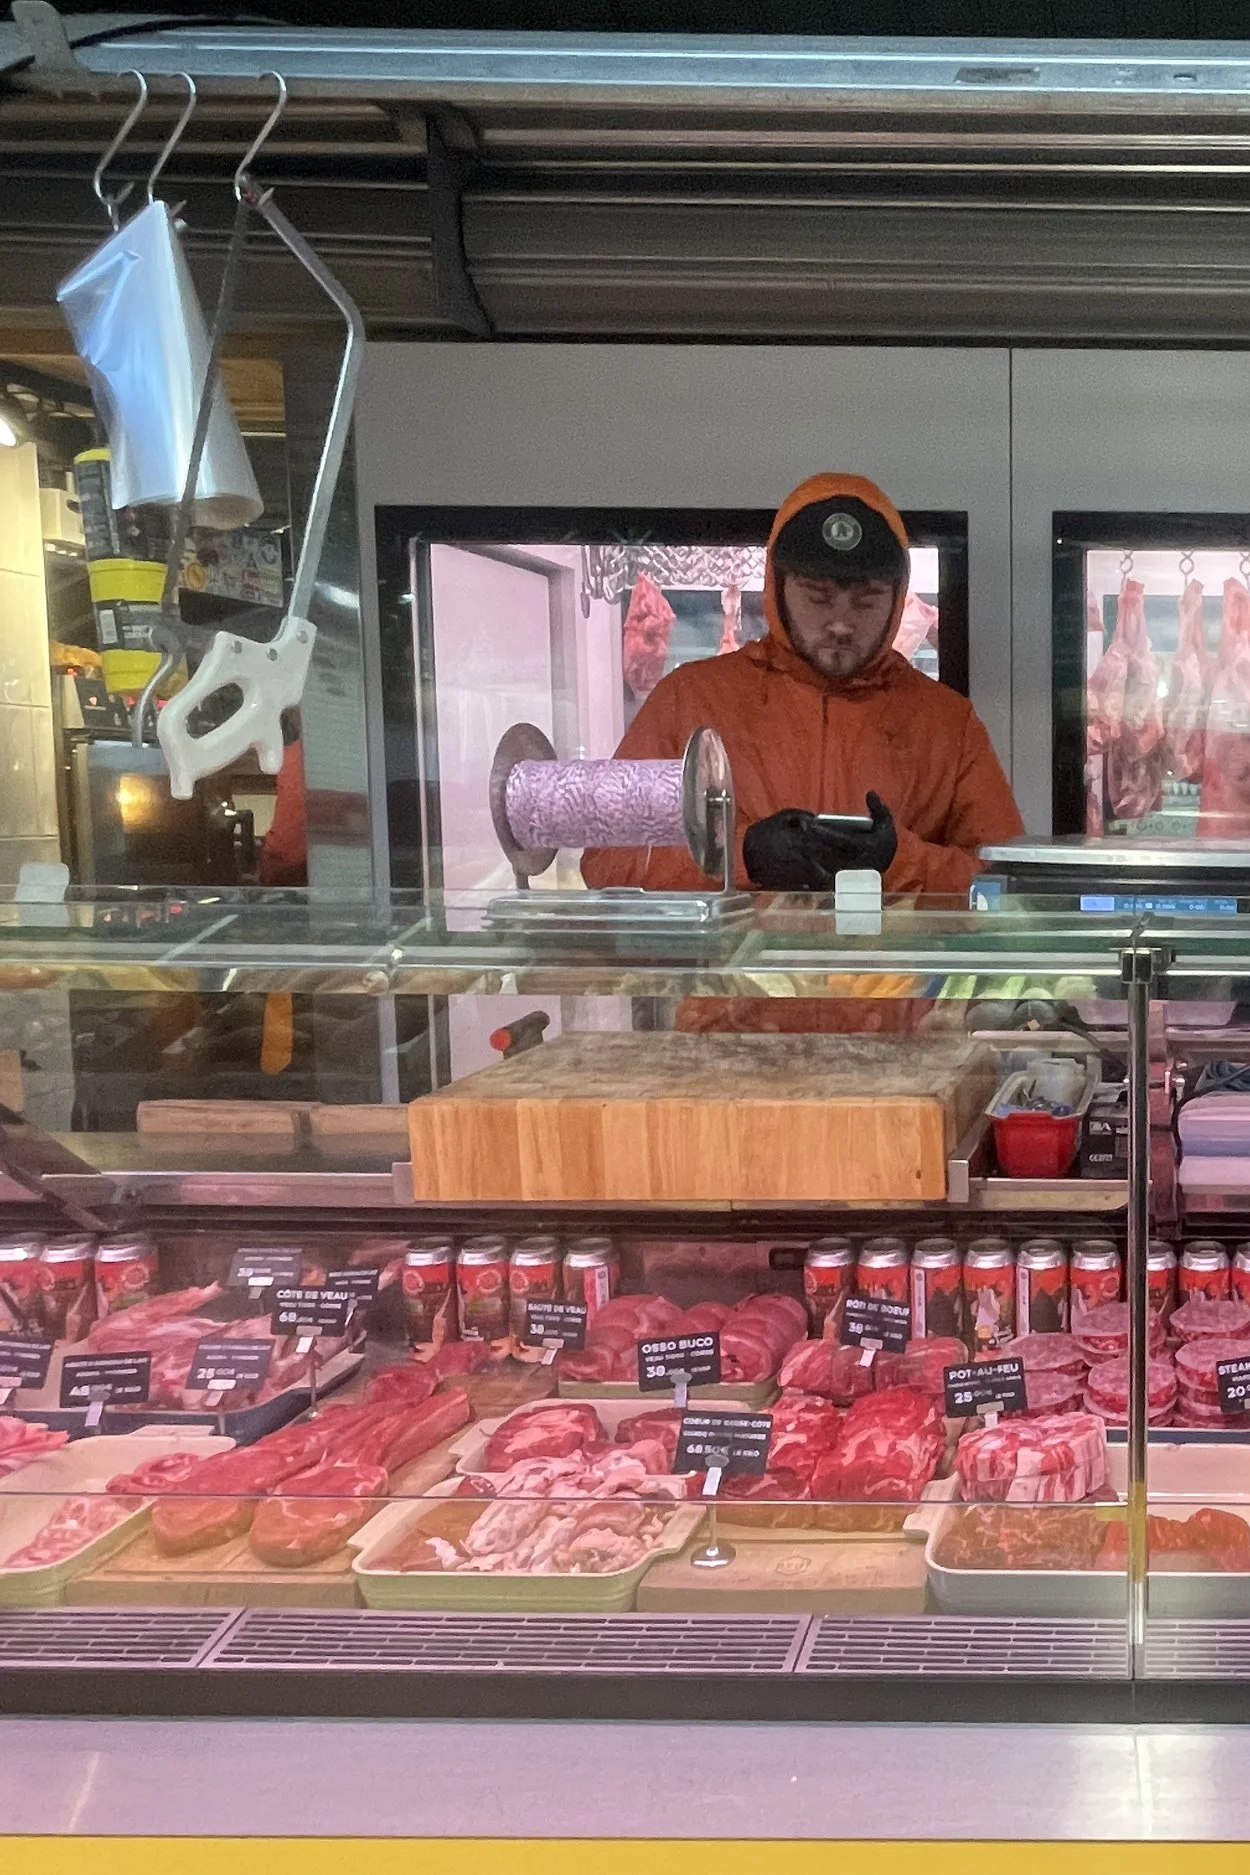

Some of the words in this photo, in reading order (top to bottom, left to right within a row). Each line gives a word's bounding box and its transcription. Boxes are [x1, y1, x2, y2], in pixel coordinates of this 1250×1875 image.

[276, 1288, 302, 1299] CÔTE
[320, 1291, 348, 1300] VEAU
[642, 1341, 677, 1354] OSSO
[678, 1336, 714, 1349] BUCO
[646, 1365, 666, 1378] 30
[948, 1362, 1019, 1380] POT-AU-FEU
[954, 1391, 974, 1404] 25
[1226, 1385, 1246, 1399] 20
